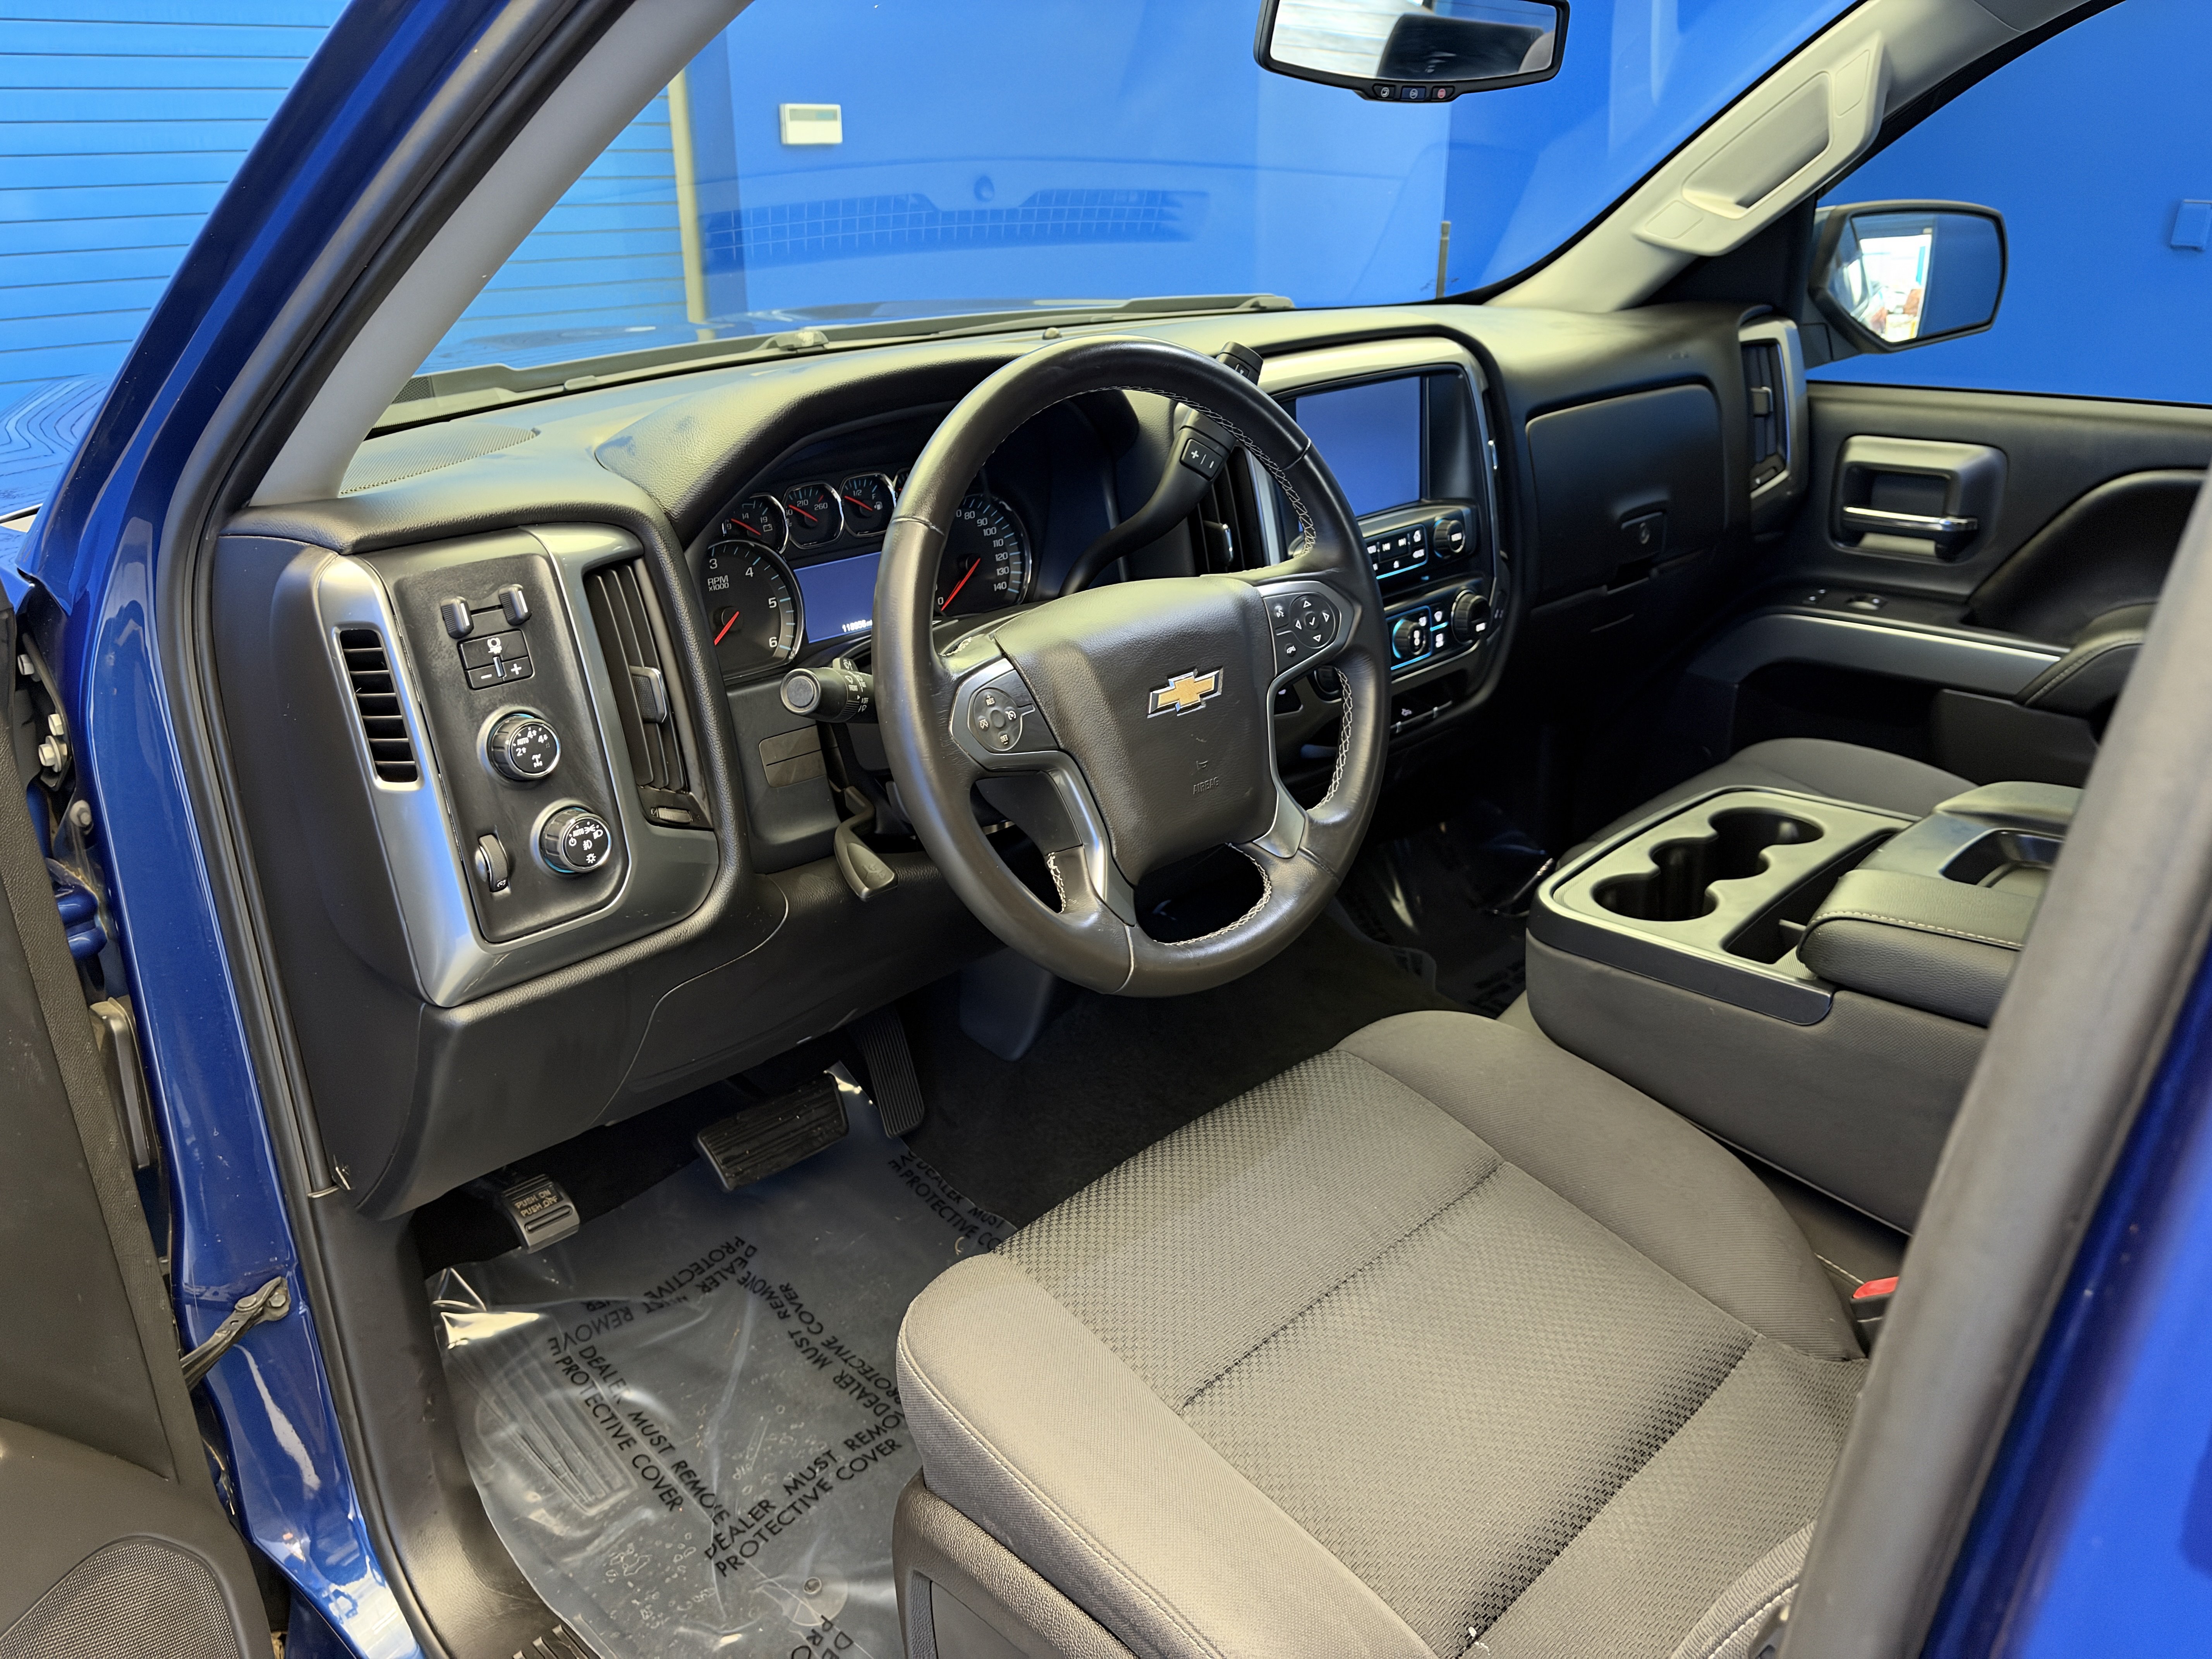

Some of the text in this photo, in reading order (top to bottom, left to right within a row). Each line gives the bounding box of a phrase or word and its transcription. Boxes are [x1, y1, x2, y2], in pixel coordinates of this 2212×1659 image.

[797, 499, 809, 507] 210
[814, 502, 828, 511] 260
[964, 510, 975, 520] 80
[977, 517, 988, 527] 90
[983, 527, 997, 536] 100
[993, 538, 1004, 548] 110
[995, 552, 1008, 562] 120
[709, 558, 718, 569] 3
[745, 567, 754, 577] 4
[996, 566, 1010, 576] 130
[708, 575, 729, 586] RPM
[708, 582, 729, 592] x1000
[993, 581, 1007, 591] 140
[768, 597, 777, 608] 5
[938, 597, 944, 605] 0
[769, 636, 778, 647] 6
[986, 697, 995, 706] RES
[517, 737, 529, 746] AUTO
[1000, 734, 1008, 743] SET
[1193, 776, 1219, 795] AIRBAG
[573, 828, 584, 837] AUTO
[514, 1189, 551, 1209] PUSH ON
[899, 1169, 979, 1238] PROTECTIVE
[520, 1195, 558, 1217] PUSH OFF
[644, 1236, 746, 1300] PROTECTIVE
[696, 1244, 757, 1294] DEALER
[780, 1282, 824, 1336] COVER
[737, 1270, 890, 1417] DEALER MUST REMOVE
[556, 1355, 684, 1512] PROTECTIVE COVER
[627, 1410, 676, 1454] MUST
[704, 1410, 906, 1561] DEALER MUST REMO
[715, 1438, 902, 1577] PROTECTIVE COVER
